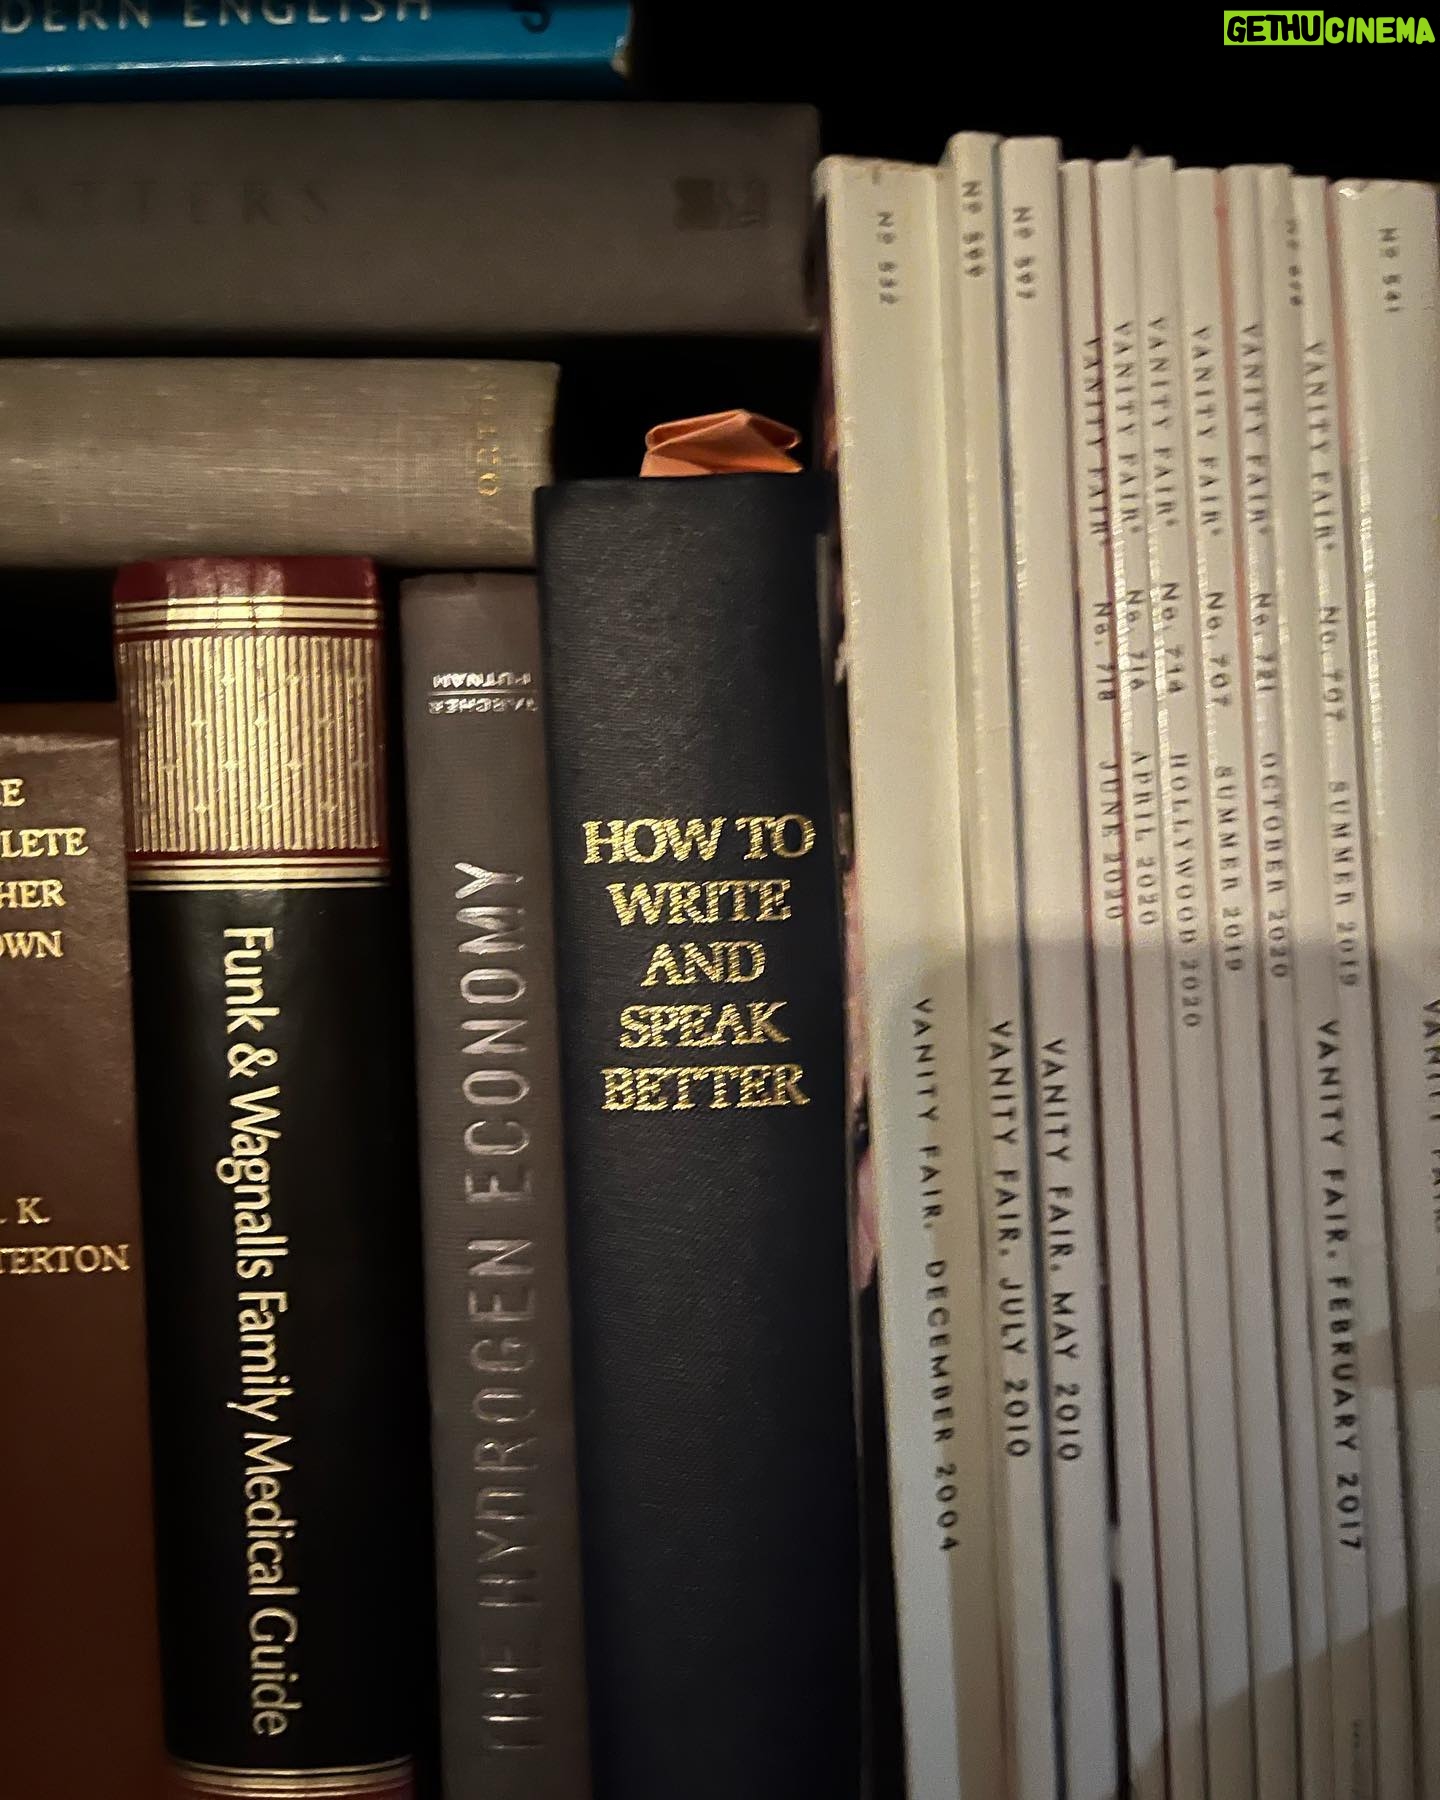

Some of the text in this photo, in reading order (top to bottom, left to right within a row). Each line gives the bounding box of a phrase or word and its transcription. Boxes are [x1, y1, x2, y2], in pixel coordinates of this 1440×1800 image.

[182, 0, 432, 27] ENGLISH
[1083, 337, 1106, 446] VANITY
[1113, 321, 1135, 435] VANITY
[1148, 317, 1171, 430] VANITY
[1192, 326, 1216, 436] VANITY
[1242, 324, 1265, 435] VANITY
[1303, 341, 1329, 451] VANITY
[582, 813, 816, 865] HOW TO
[1098, 760, 1122, 838] JUNE
[1131, 751, 1156, 842] APRIL
[1214, 766, 1240, 892] SUMMER
[1260, 752, 1285, 893] OCTOBER
[1103, 852, 1125, 920] 2020
[1170, 753, 1197, 944] HOLLYWOOD
[1328, 780, 1355, 905] SUMMER
[605, 878, 793, 927] WRITE
[1136, 856, 1158, 925] 2020
[0, 930, 65, 960] WN
[640, 940, 767, 988] AND
[1222, 906, 1243, 971] 2019
[1268, 910, 1289, 978] 2020
[1336, 920, 1359, 986] 2019
[455, 860, 536, 1204] ECONOMY
[619, 1001, 793, 1049] SPEAK
[1180, 959, 1202, 1027] 2020
[601, 1063, 811, 1112] BETTER
[912, 997, 939, 1122] VANITY
[988, 1020, 1019, 1145] VANITY
[1040, 1037, 1073, 1163] VANITY
[1316, 1019, 1347, 1147] VANITY
[216, 926, 303, 1737] Funk & Wagnalls Family Medical Guide
[925, 1259, 955, 1444] DECEMBER
[999, 1276, 1027, 1355] JULY
[1051, 1290, 1081, 1360] MAY
[1327, 1275, 1359, 1451] FEBRUARY
[467, 1238, 540, 1609] HYDROGEN
[1004, 1377, 1031, 1457] 2010
[1054, 1382, 1083, 1462] 2010
[935, 1463, 961, 1551] 2004
[1336, 1472, 1362, 1550] 2017
